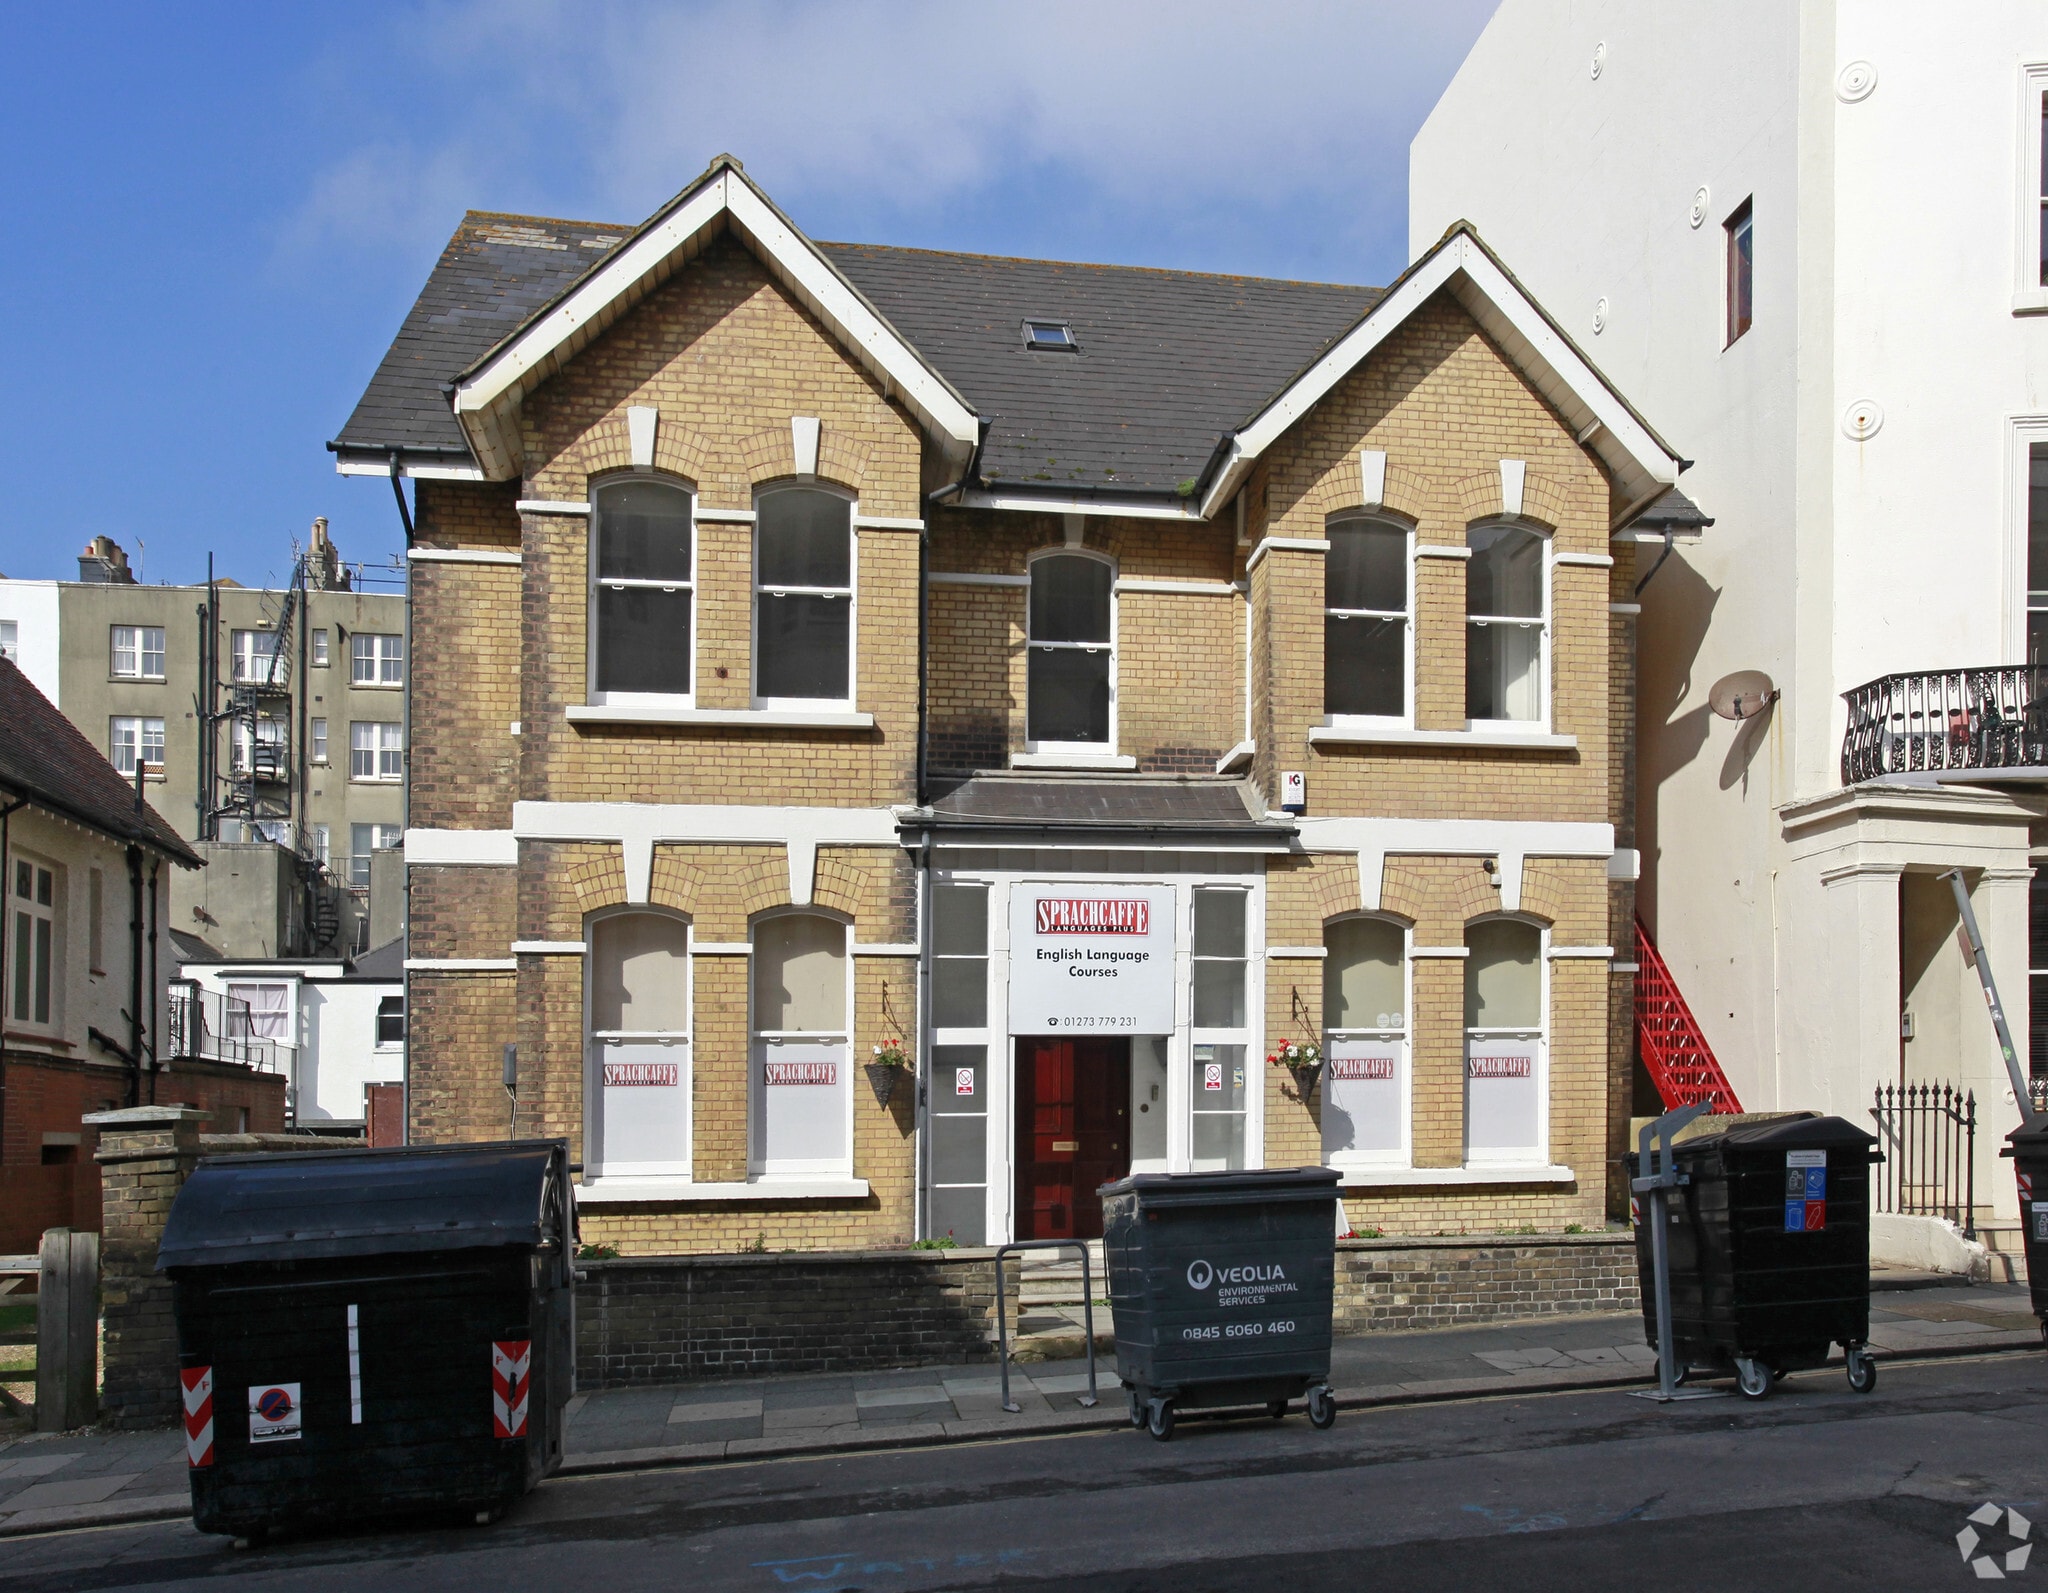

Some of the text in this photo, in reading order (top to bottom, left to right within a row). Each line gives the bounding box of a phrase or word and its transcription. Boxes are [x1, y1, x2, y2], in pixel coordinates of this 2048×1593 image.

[1038, 900, 1148, 933] SPRACHCAFFE
[1036, 949, 1150, 963] English Language
[1069, 966, 1118, 977] Courses
[1064, 1017, 1138, 1027] 01273 779 231
[604, 1064, 677, 1086] SPRACHCAFFE
[766, 1063, 836, 1085] SPRACHCAFFE
[1330, 1059, 1393, 1079] SPRACHCAFFE
[1469, 1057, 1530, 1077] SPRACHCAFFE
[1216, 1264, 1285, 1284] VEOLIA
[1218, 1283, 1299, 1297] ENVIRONMENTAL
[1219, 1295, 1266, 1307] SERVICES
[1183, 1320, 1296, 1340] 0845 6060 460
